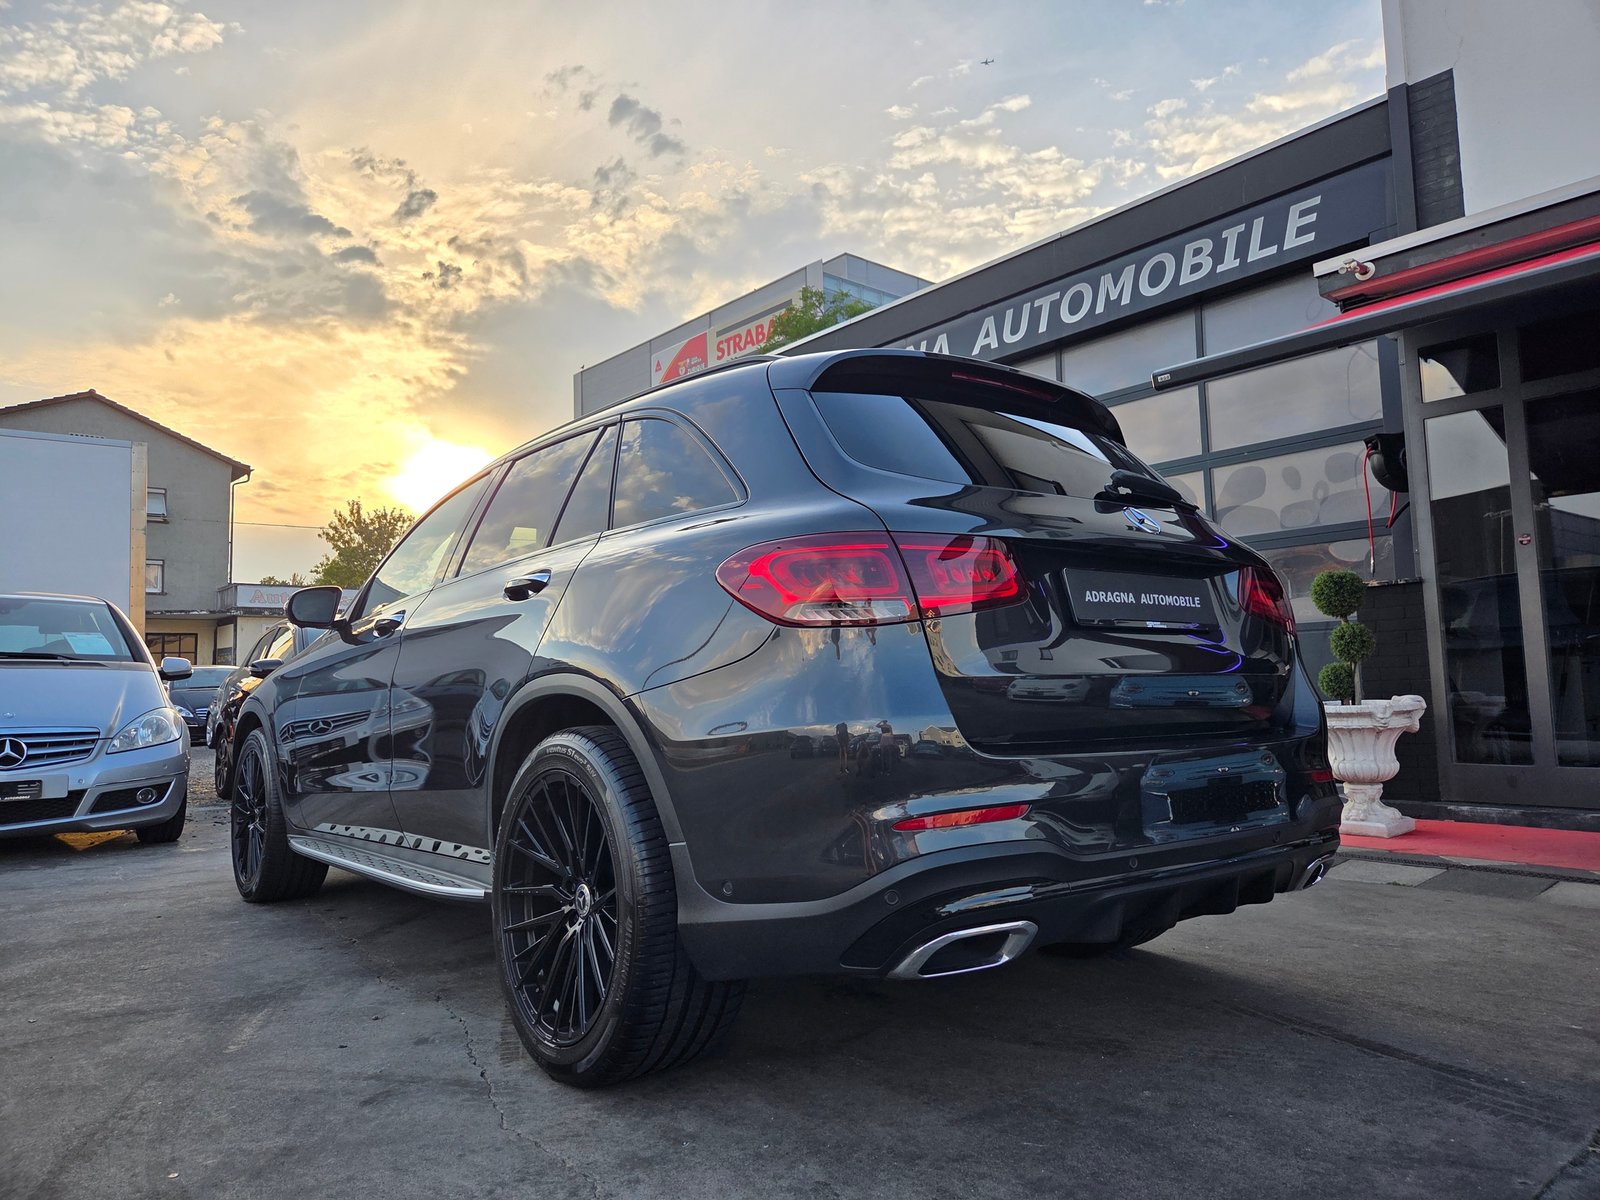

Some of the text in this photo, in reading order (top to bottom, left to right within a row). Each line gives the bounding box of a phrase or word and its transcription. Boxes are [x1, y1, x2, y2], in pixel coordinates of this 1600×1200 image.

[971, 195, 1321, 355] AUTOMOBILE
[716, 311, 789, 360] STRABA
[1085, 590, 1201, 608] ADRAGNA AUTOMOBILE
